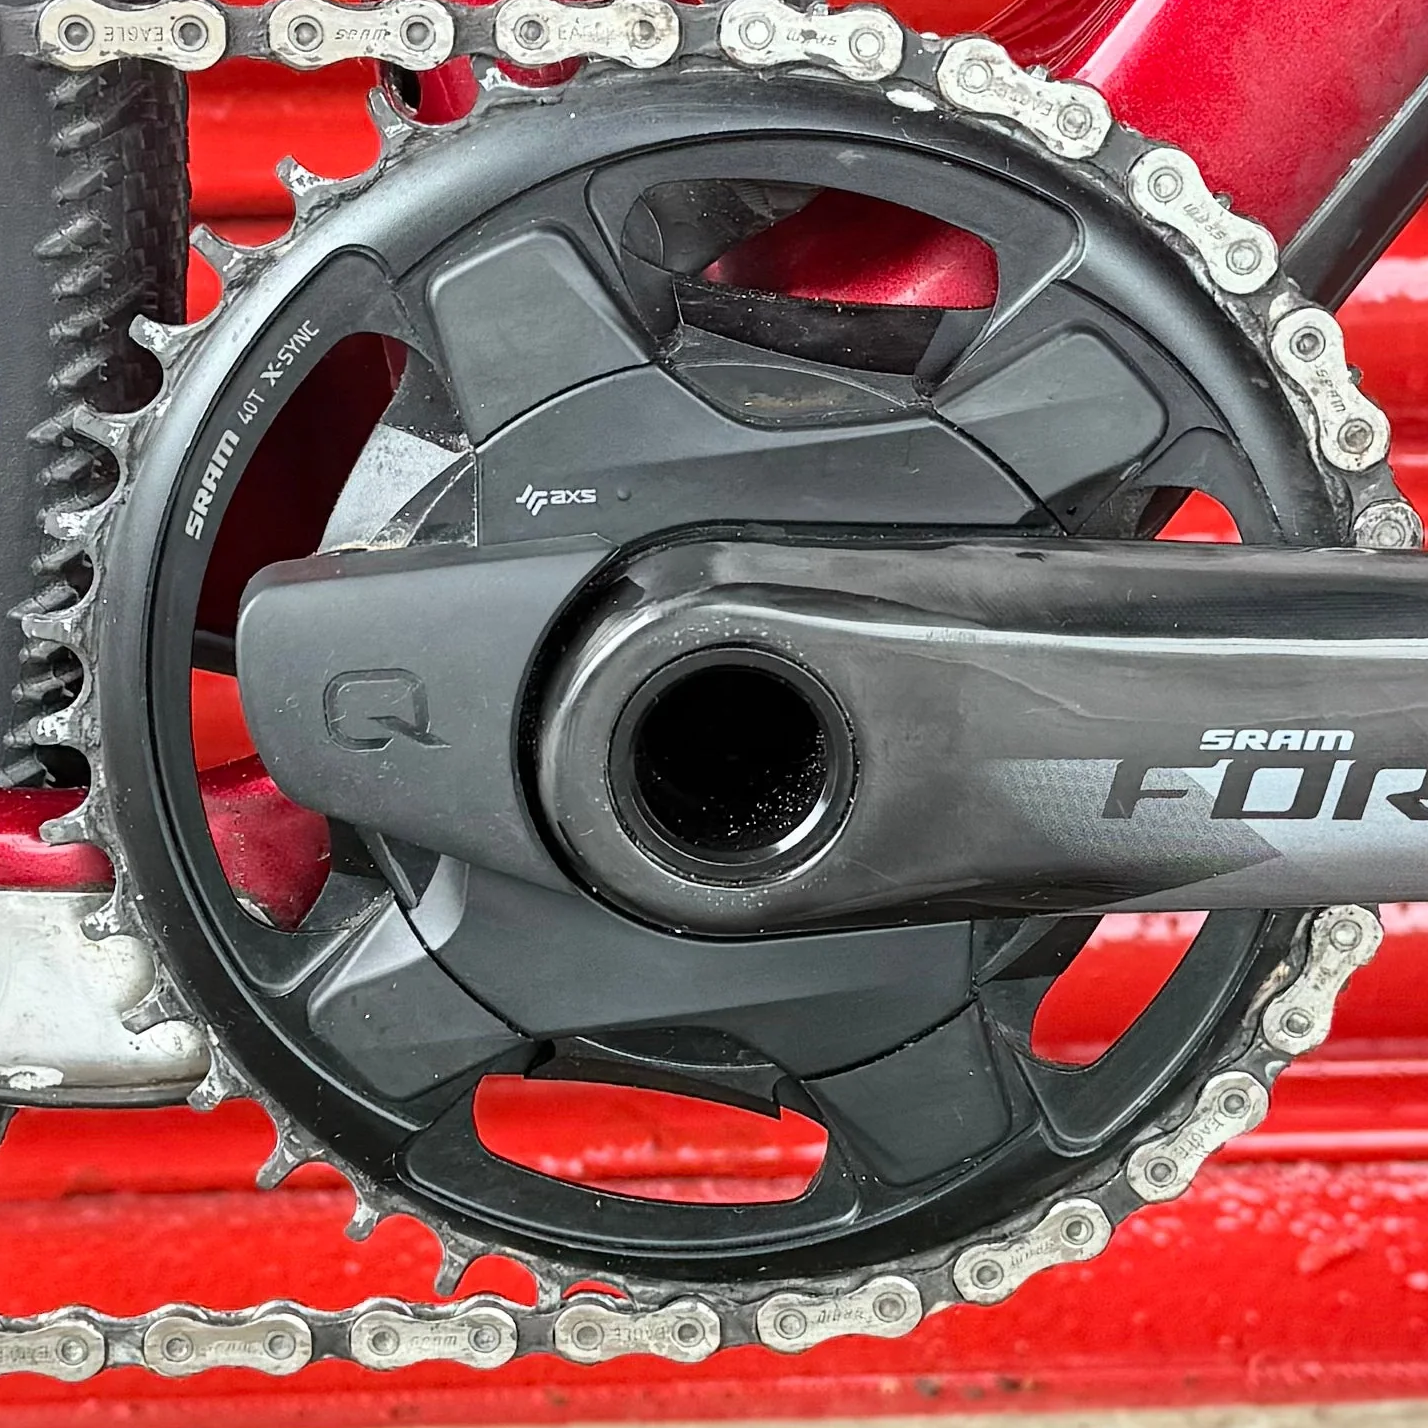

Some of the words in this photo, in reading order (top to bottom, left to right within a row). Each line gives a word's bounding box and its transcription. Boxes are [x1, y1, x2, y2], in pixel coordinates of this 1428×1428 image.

[103, 26, 163, 41] EAGLE
[184, 429, 240, 540] SRAM
[236, 388, 265, 425] 40T
[259, 320, 320, 387] X-SYNC
[322, 667, 452, 753] Q
[1199, 728, 1355, 752] SRAM
